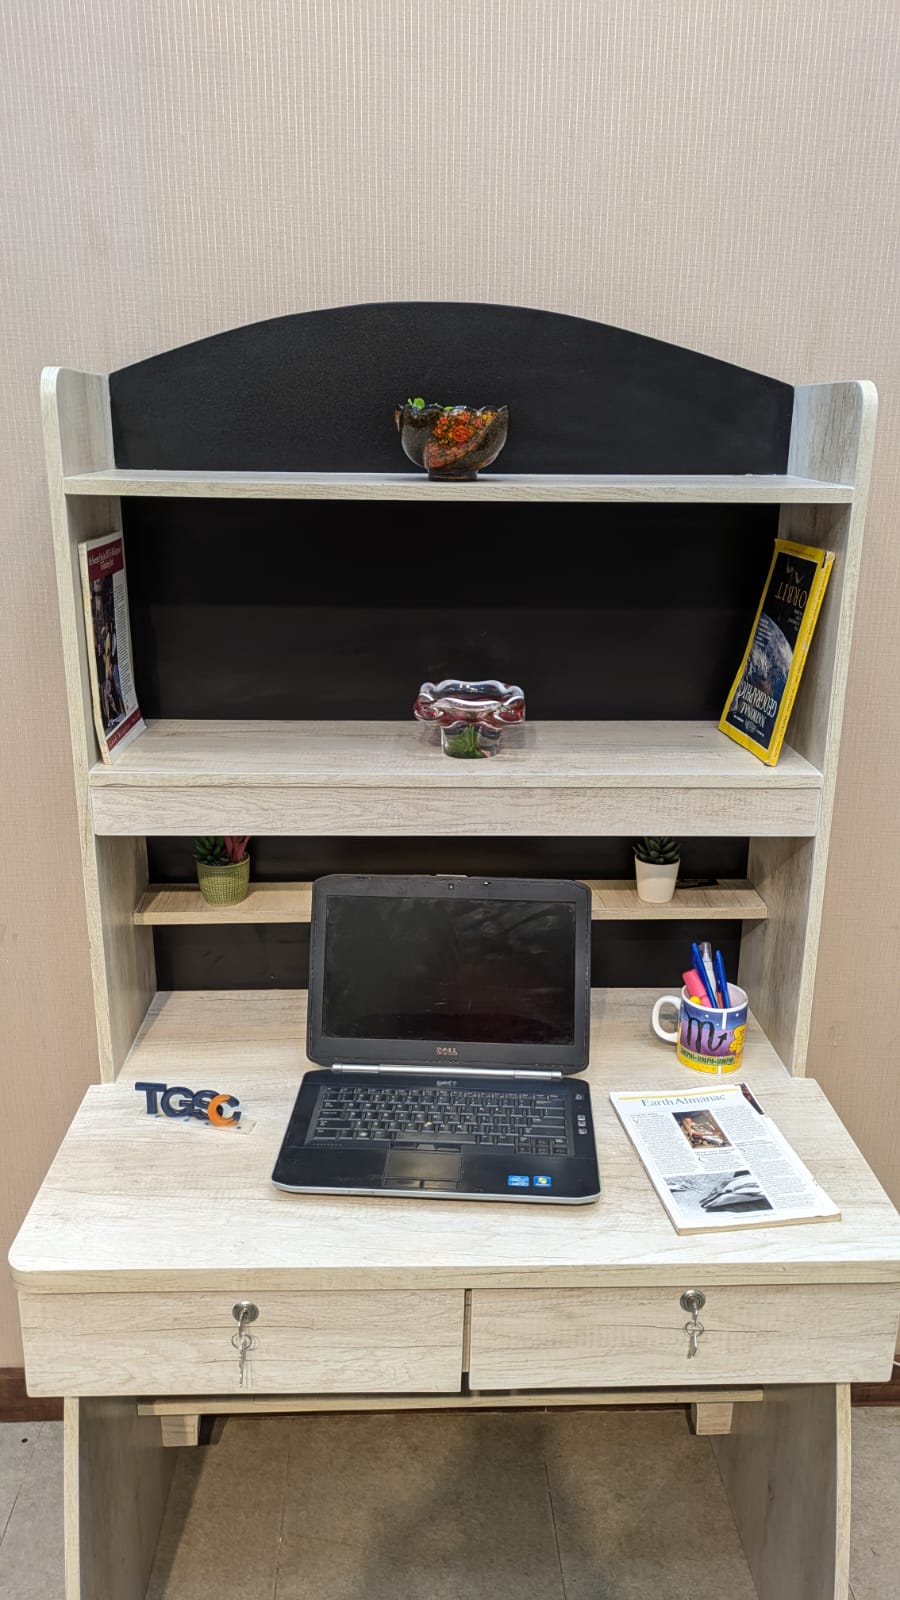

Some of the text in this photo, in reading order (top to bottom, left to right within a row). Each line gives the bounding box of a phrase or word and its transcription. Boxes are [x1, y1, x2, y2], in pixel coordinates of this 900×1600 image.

[774, 582, 808, 609] ORBIT
[737, 680, 778, 718] GEOGRAPHIC
[739, 701, 767, 728] NATIONAL
[641, 1094, 726, 1107] Earth Almanac
